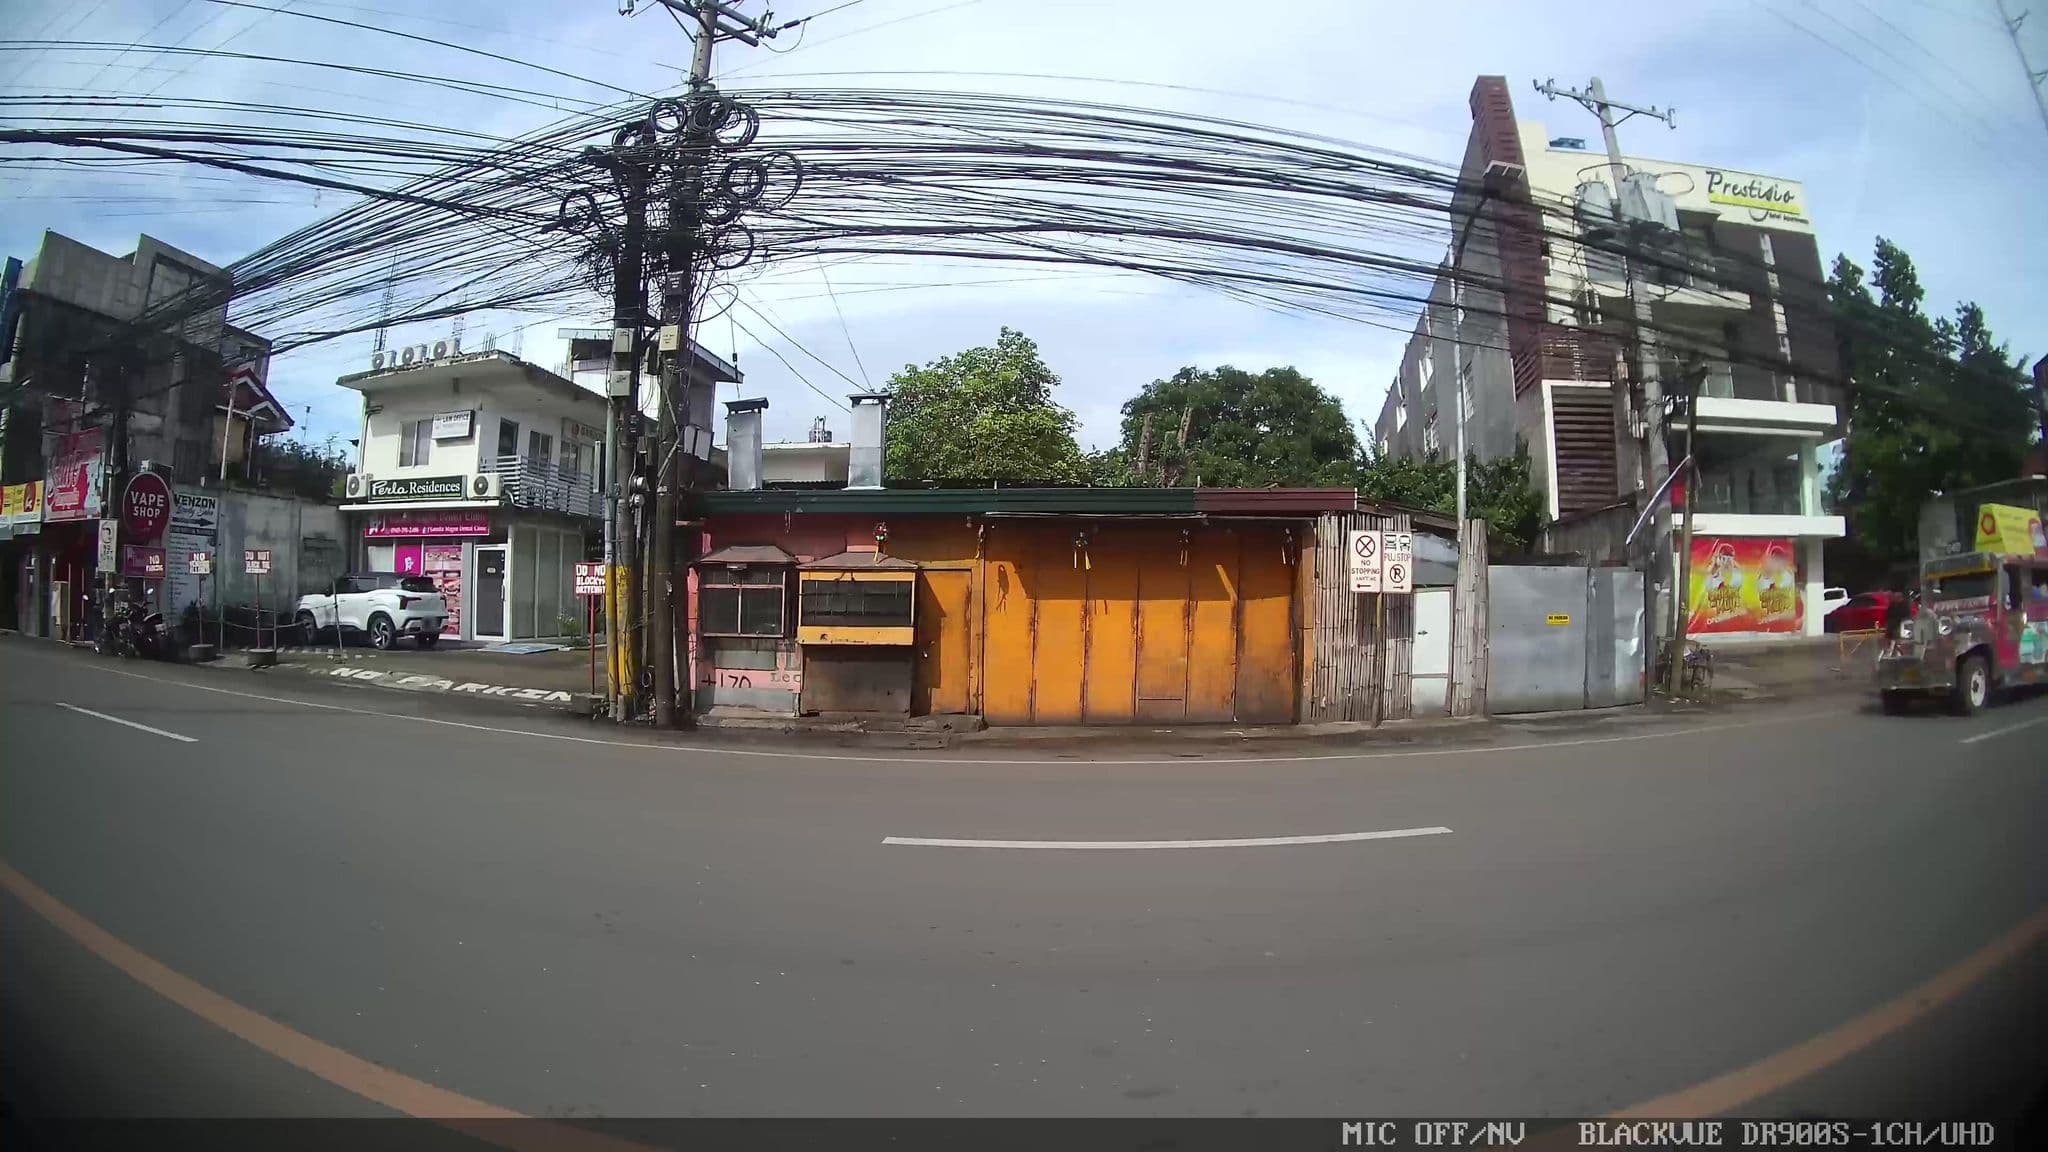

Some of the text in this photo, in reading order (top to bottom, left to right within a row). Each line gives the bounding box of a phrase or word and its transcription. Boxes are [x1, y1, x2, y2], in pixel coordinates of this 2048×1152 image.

[453, 413, 469, 421] OFFICE
[372, 481, 461, 497] Perla Residences
[131, 491, 165, 507] VAPE
[173, 494, 216, 510] VENZON
[133, 506, 161, 519] SHOP
[149, 554, 160, 565] NO
[193, 552, 206, 561] NO
[245, 551, 254, 561] DO
[1396, 553, 1411, 562] STOP
[576, 564, 606, 577] DO NO
[1351, 567, 1380, 575] STOPPING
[576, 576, 599, 586] BLOCK
[329, 667, 573, 702] NO PARKIN
